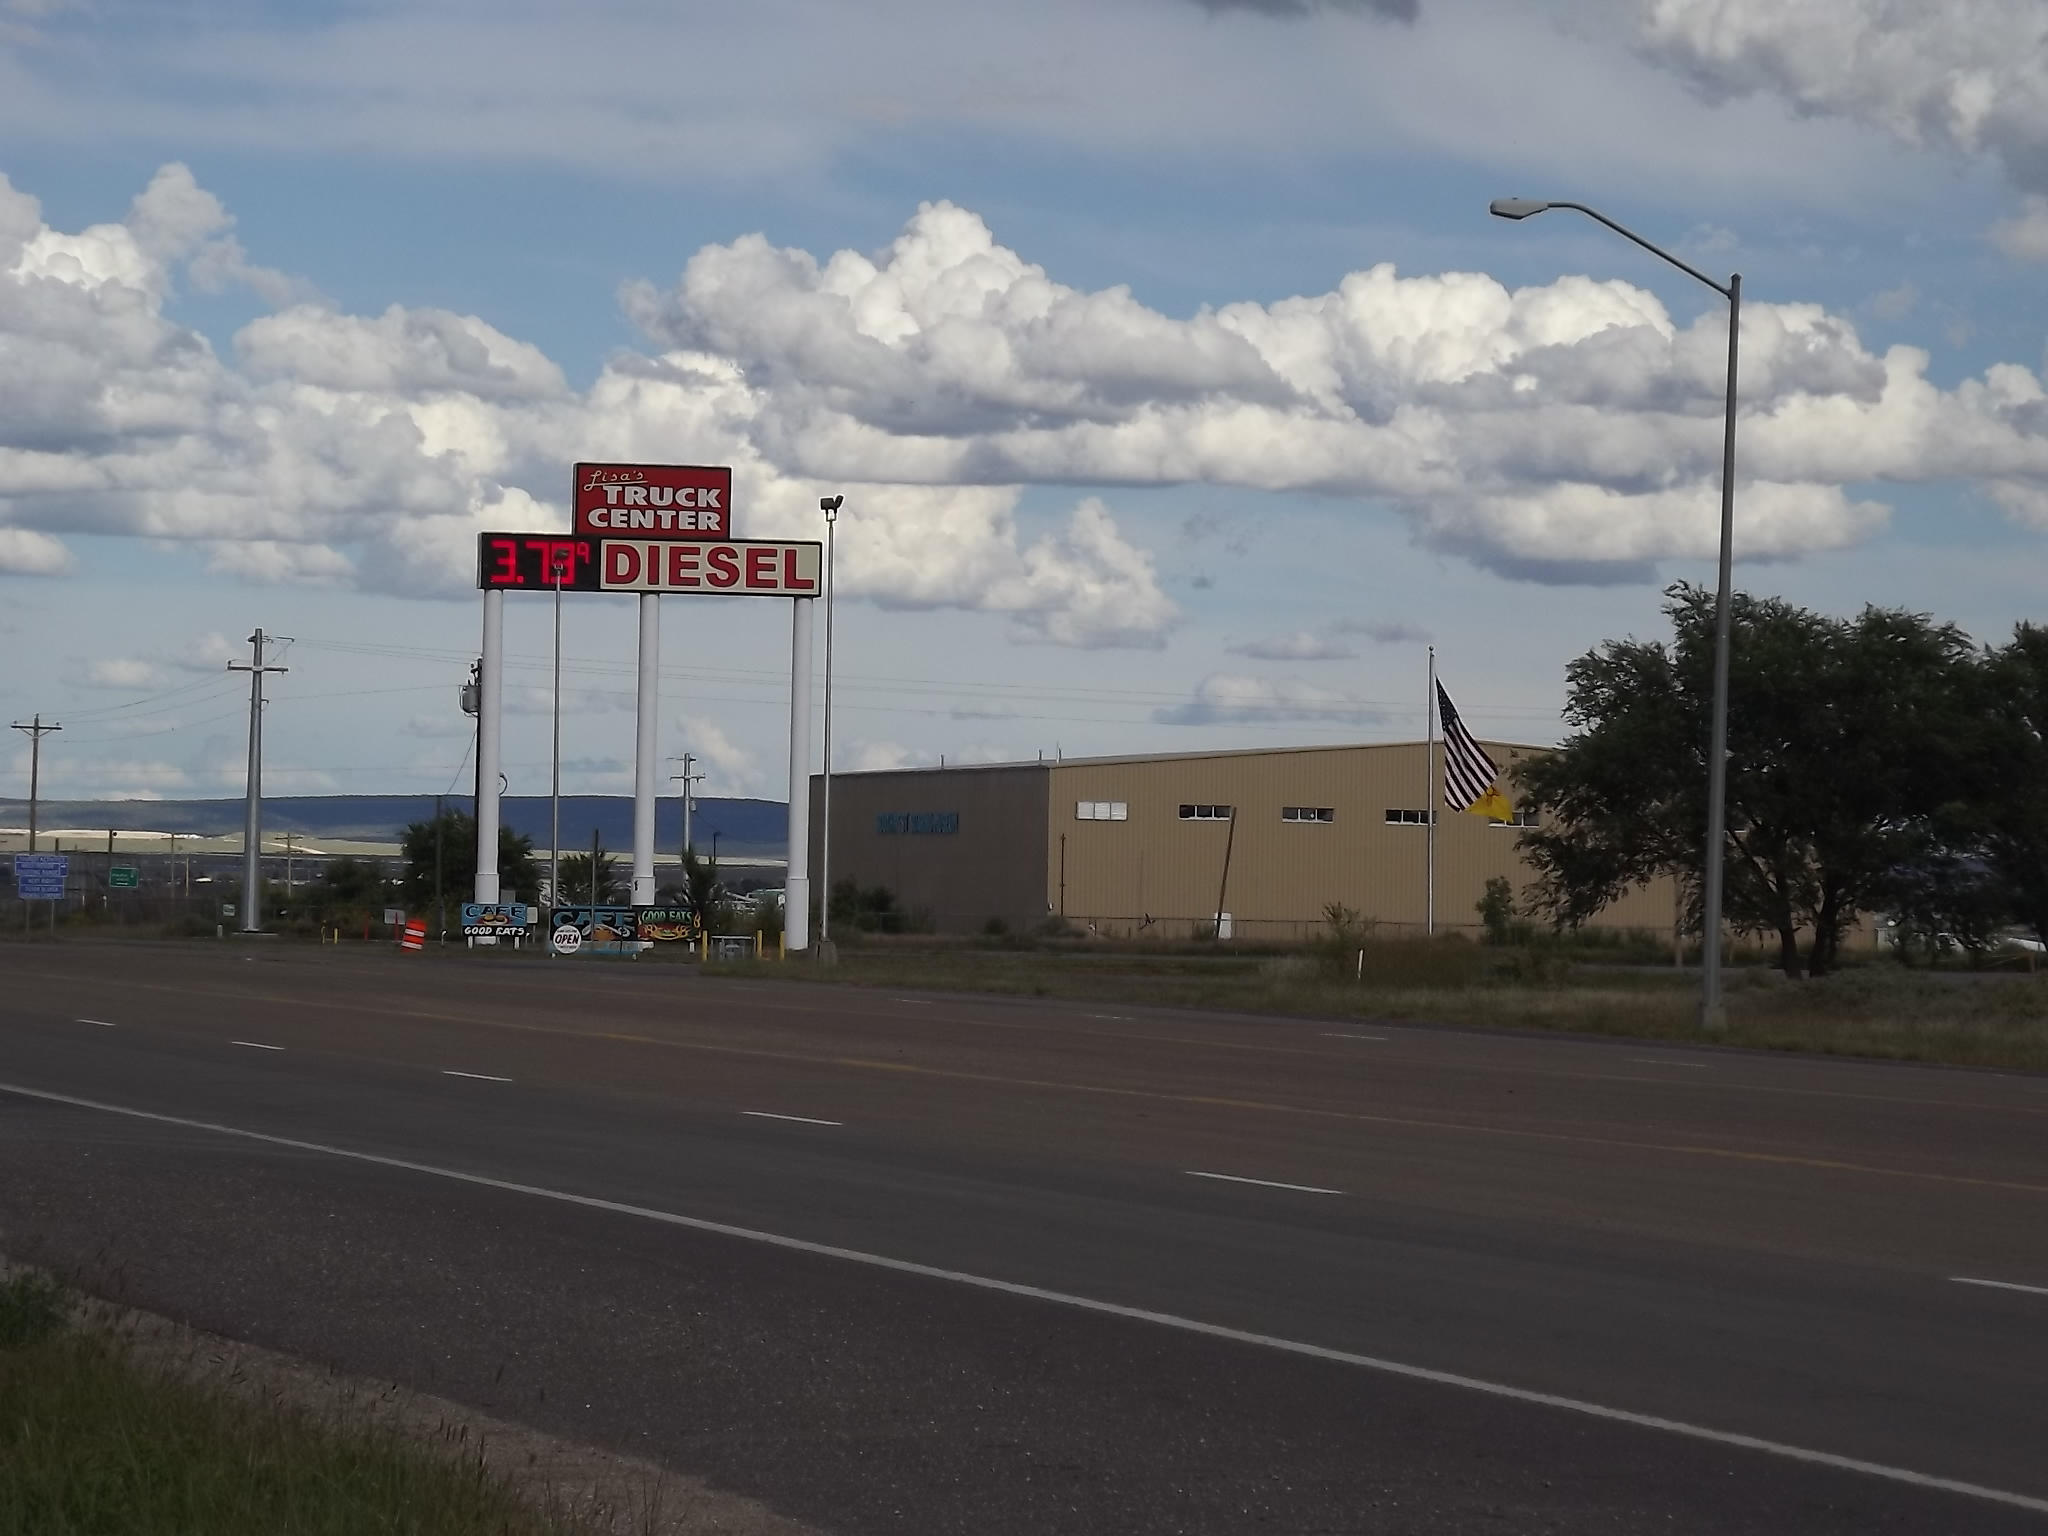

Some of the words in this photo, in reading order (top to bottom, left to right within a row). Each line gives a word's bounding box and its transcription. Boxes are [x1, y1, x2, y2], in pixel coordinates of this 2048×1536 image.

[583, 469, 648, 491] Lisa's
[603, 485, 722, 508] TRUCK
[588, 508, 721, 531] CENTER
[604, 543, 815, 590] DIESEL
[465, 905, 525, 920] CAFE
[641, 910, 666, 921] GOOD
[669, 910, 693, 921] EATS
[464, 926, 492, 935] GOOD
[555, 934, 580, 944] OPEN
